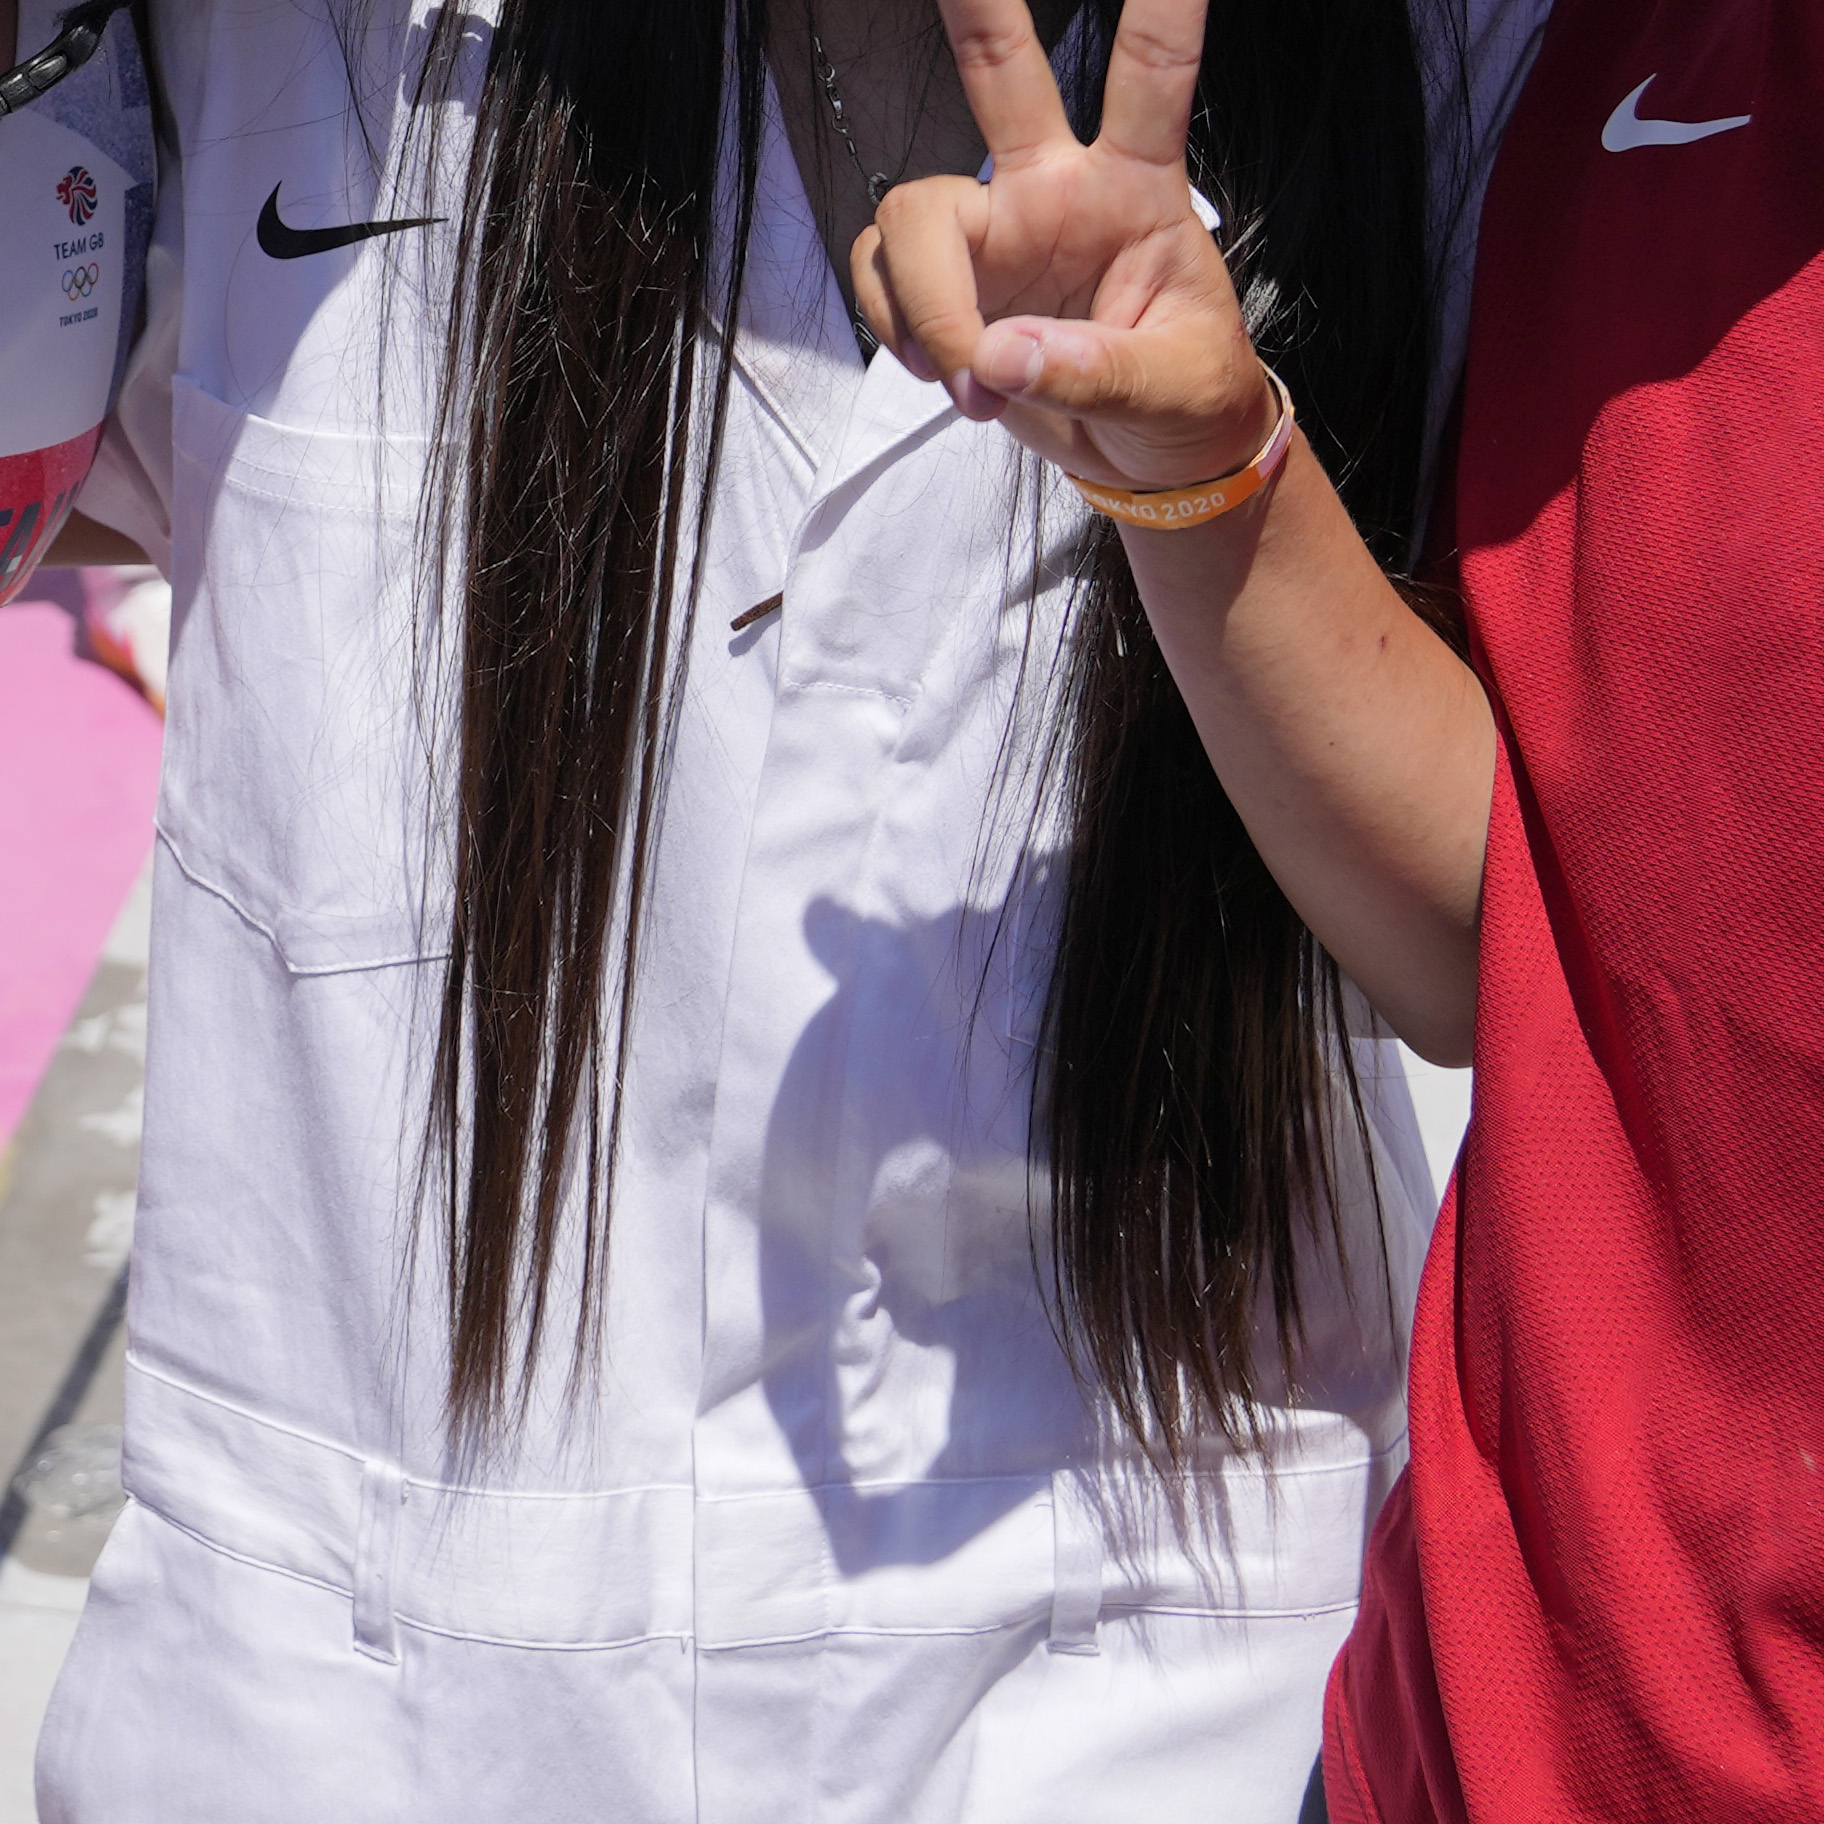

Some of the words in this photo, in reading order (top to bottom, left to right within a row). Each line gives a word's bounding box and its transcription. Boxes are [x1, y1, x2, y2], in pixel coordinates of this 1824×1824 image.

[54, 237, 87, 261] TEAM
[89, 232, 104, 251] GB
[1160, 491, 1226, 521] 2020
